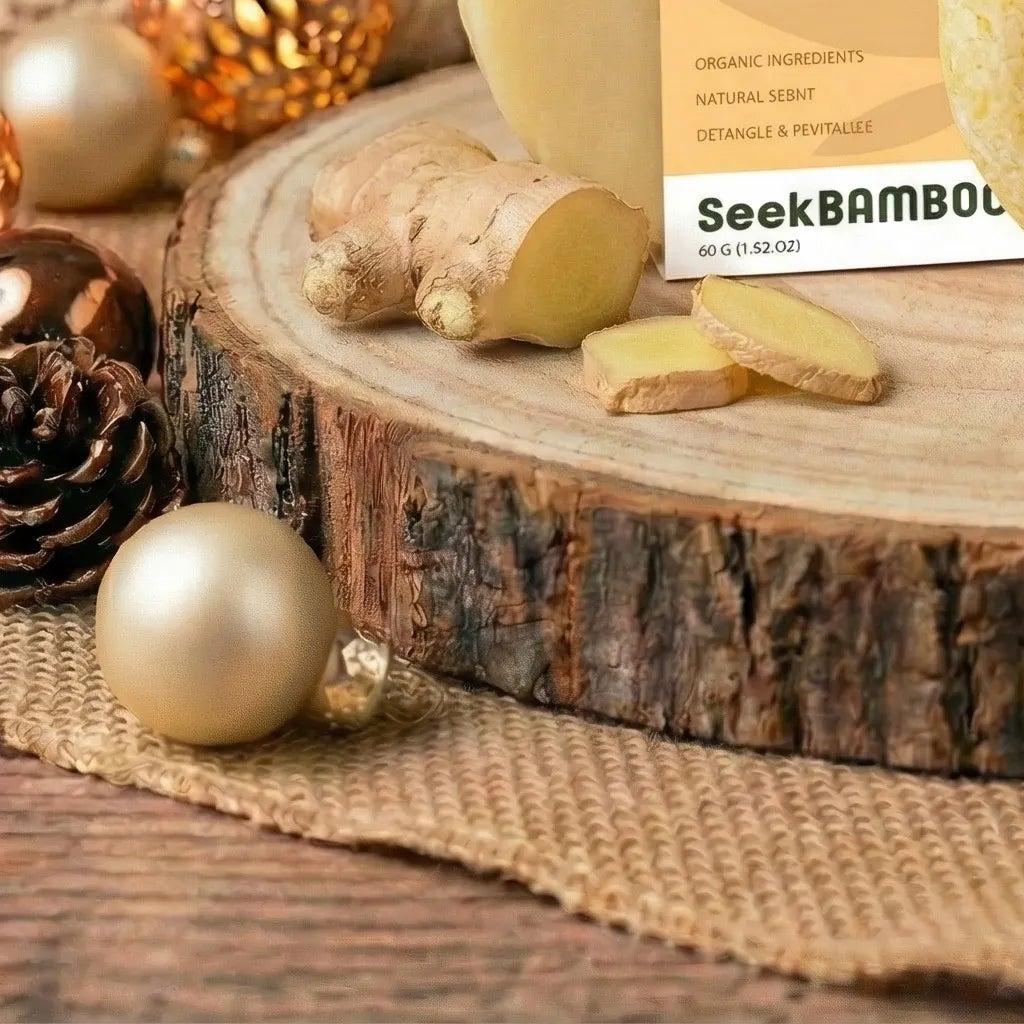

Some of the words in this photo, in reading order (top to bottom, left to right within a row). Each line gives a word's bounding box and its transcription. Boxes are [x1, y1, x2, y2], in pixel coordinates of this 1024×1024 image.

[695, 54, 763, 71] ORGANIC
[767, 49, 865, 67] INGREDIENTS
[695, 90, 765, 106] NATURAL
[768, 87, 816, 103] SEBNT
[697, 125, 773, 142] DETANGLE
[777, 124, 789, 138] &
[698, 244, 717, 258] 60
[720, 243, 732, 257] G
